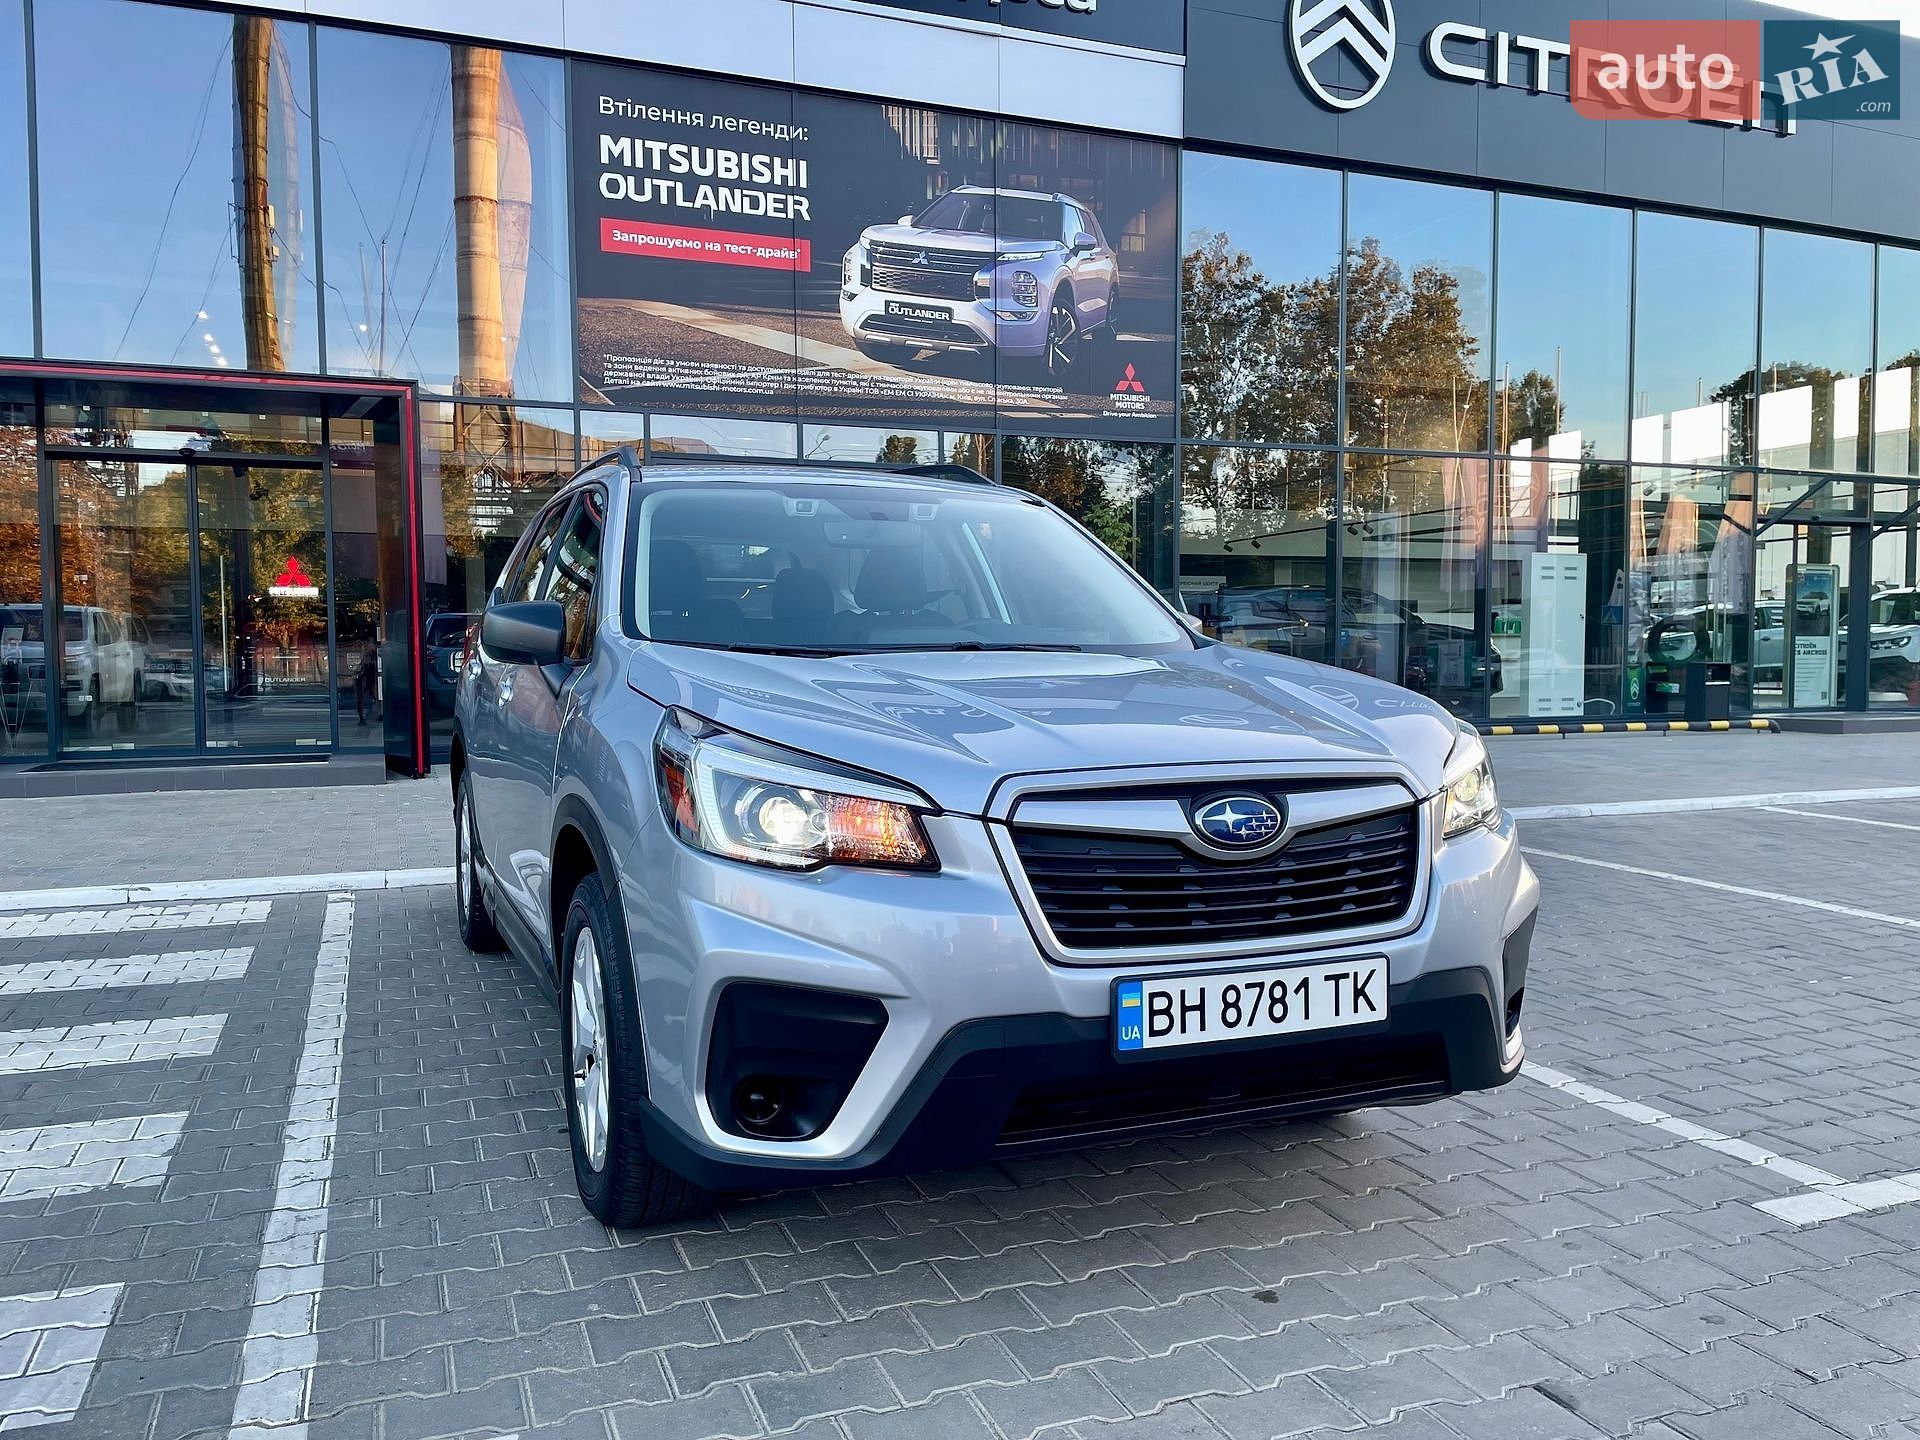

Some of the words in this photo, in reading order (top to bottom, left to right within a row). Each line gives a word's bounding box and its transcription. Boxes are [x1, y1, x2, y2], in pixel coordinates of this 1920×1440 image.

[599, 95, 704, 127] Втілення
[710, 115, 809, 142] легенди:
[599, 134, 808, 189] MITSUBISHI
[599, 172, 811, 221] OUTLANDER
[612, 229, 702, 249] Запрошуємо
[704, 241, 721, 252] на
[888, 306, 950, 321] OUTLANDER
[667, 367, 703, 375] активних
[603, 376, 630, 385] Деталі
[661, 381, 774, 395] www.mitsubishi-motors.com.ua
[864, 387, 880, 395] ТОВ
[1109, 393, 1151, 402] MITSUBISHI
[1115, 401, 1146, 410] MOTORS
[1148, 986, 1207, 1038] BH
[1220, 976, 1310, 1029] 8781
[1323, 968, 1377, 1017] TK
[1121, 1024, 1141, 1041] UA
